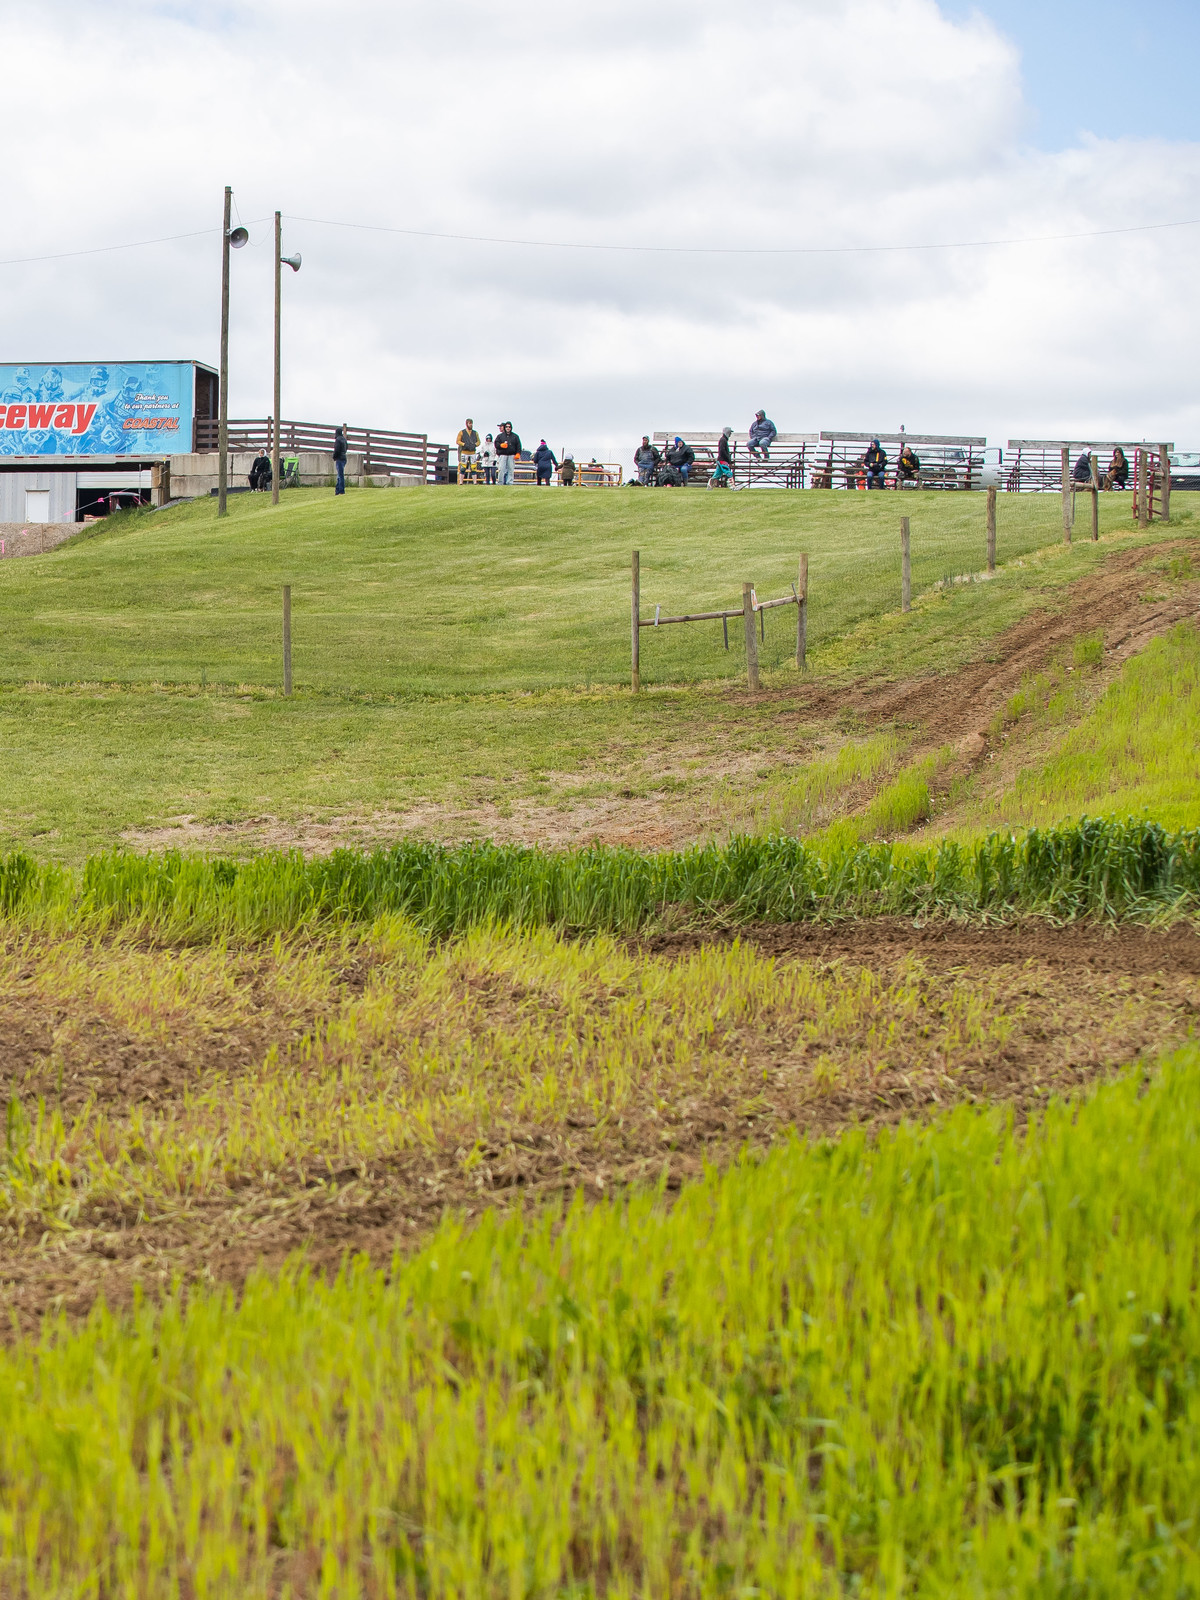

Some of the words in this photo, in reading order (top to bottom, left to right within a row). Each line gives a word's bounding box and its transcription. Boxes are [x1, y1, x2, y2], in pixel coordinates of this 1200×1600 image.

[135, 393, 156, 401] Thank
[156, 395, 169, 403] you
[143, 403, 171, 411] partners
[122, 417, 180, 430] COASTAL
